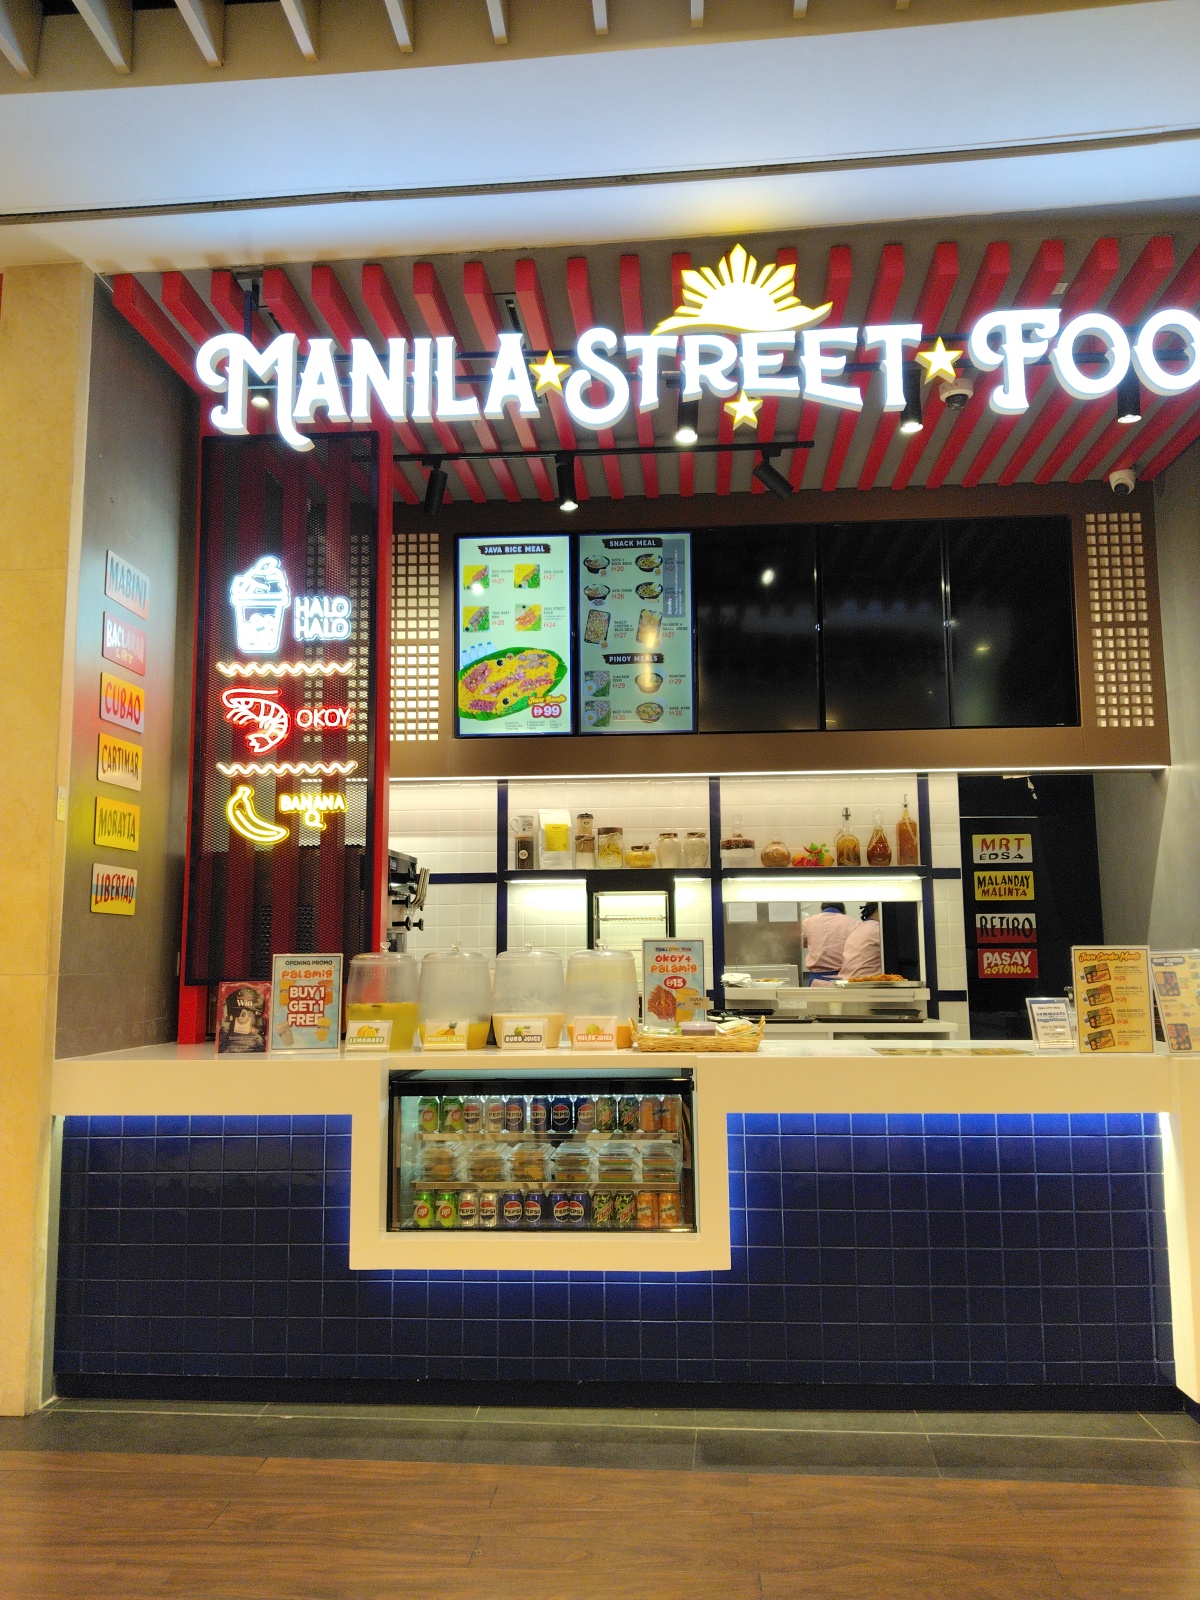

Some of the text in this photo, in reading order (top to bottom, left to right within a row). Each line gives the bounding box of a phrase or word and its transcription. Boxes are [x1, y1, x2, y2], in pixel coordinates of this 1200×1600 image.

[196, 332, 540, 451] MANILA
[564, 325, 923, 431] STREET
[109, 557, 147, 610] MABINI
[295, 597, 349, 618] HALO
[294, 617, 350, 639] HALO
[106, 619, 144, 664] BACLARAN
[116, 648, 134, 664] LRT
[104, 682, 141, 726] CUBAO
[296, 709, 350, 728] OKOY
[102, 744, 139, 780] CARTIMAR
[280, 795, 347, 812] BANANA
[98, 808, 136, 844] MORAYTA
[304, 810, 326, 829] Q
[980, 838, 1024, 852] MRT
[980, 852, 1024, 860] EDSA
[94, 872, 135, 906] LIBERTAD
[978, 875, 1030, 889] MALANDAY
[982, 887, 1028, 897] MALINTA
[980, 916, 1033, 938] RETIRO
[983, 951, 1032, 968] PASAY
[984, 965, 1032, 974] ROTONDA
[290, 987, 324, 998] BUY 1
[289, 1001, 324, 1012] GET 1
